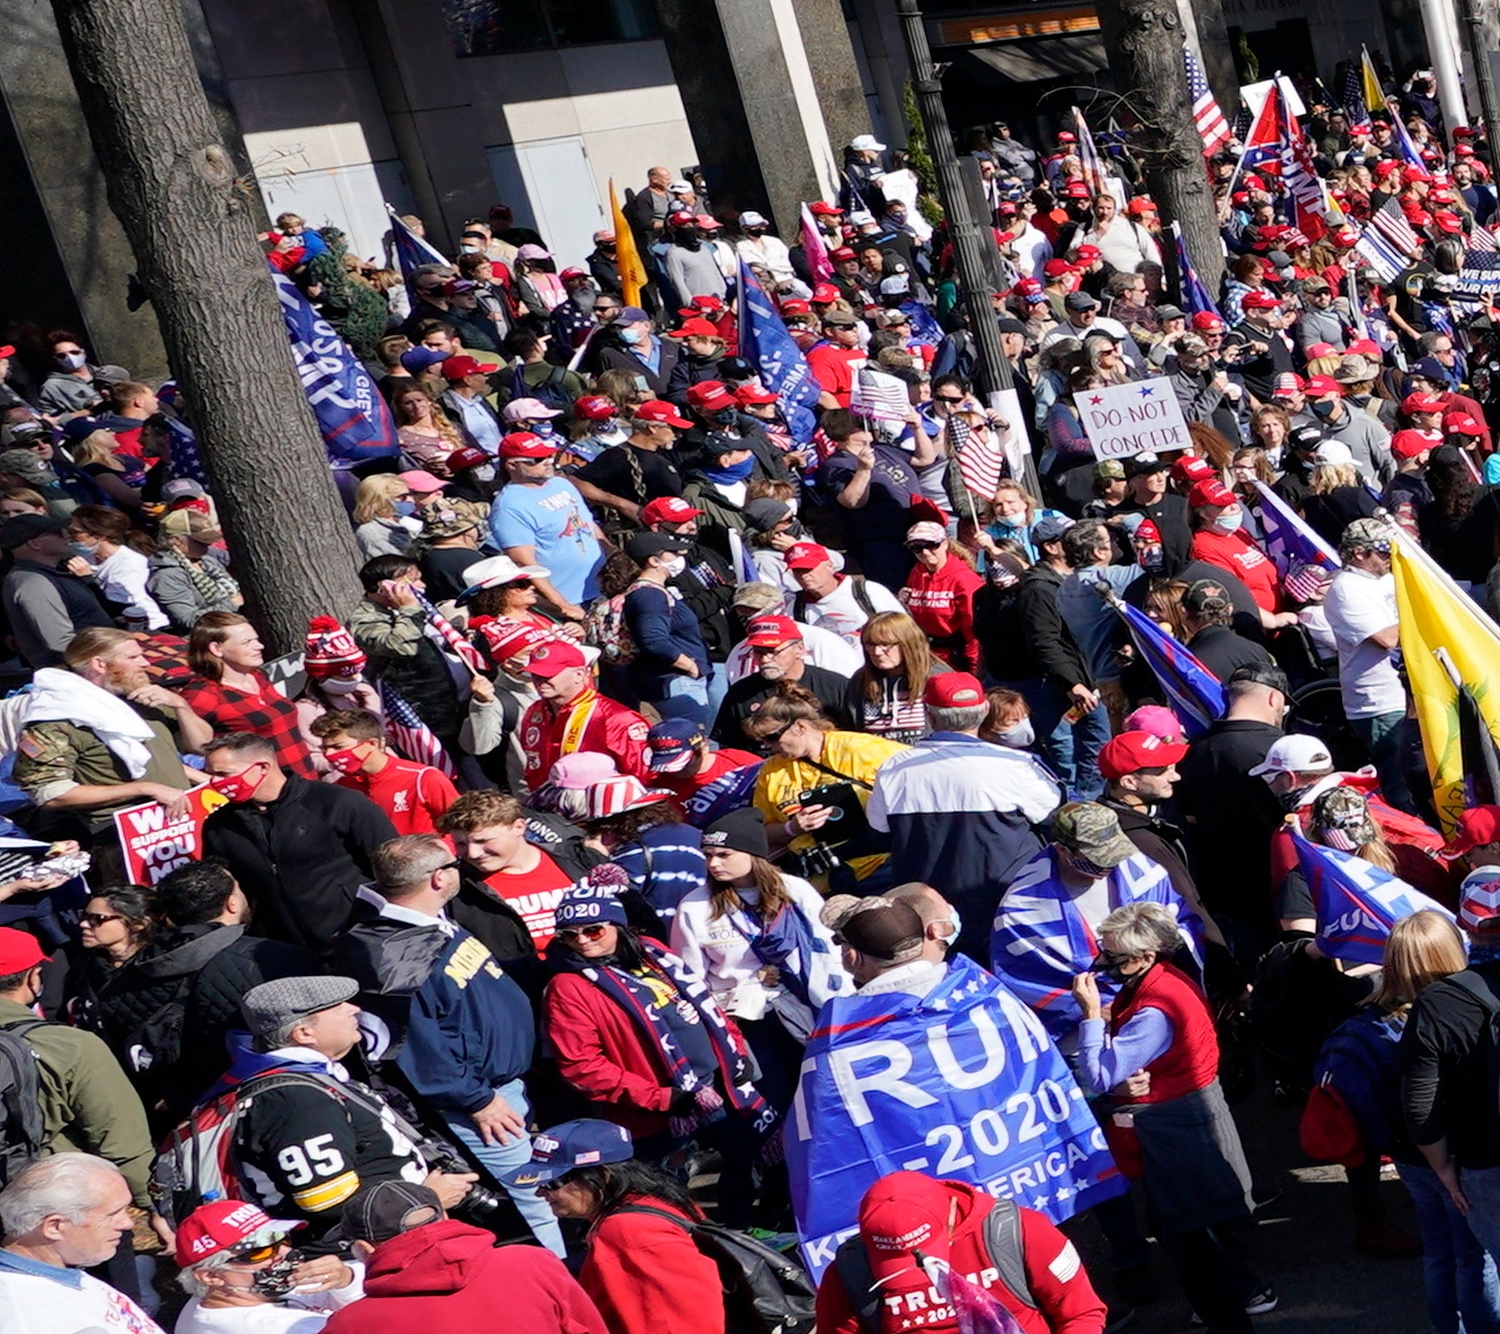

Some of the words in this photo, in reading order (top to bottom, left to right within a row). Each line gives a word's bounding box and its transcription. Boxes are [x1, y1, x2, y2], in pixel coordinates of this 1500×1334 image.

[1453, 282, 1479, 294] OUR
[1098, 425, 1184, 456] CONCEDE
[131, 819, 198, 853] SUPPORT
[135, 837, 198, 873] YOU
[556, 899, 603, 926] 2020
[277, 1133, 345, 1187] 95
[191, 1234, 218, 1255] 45
